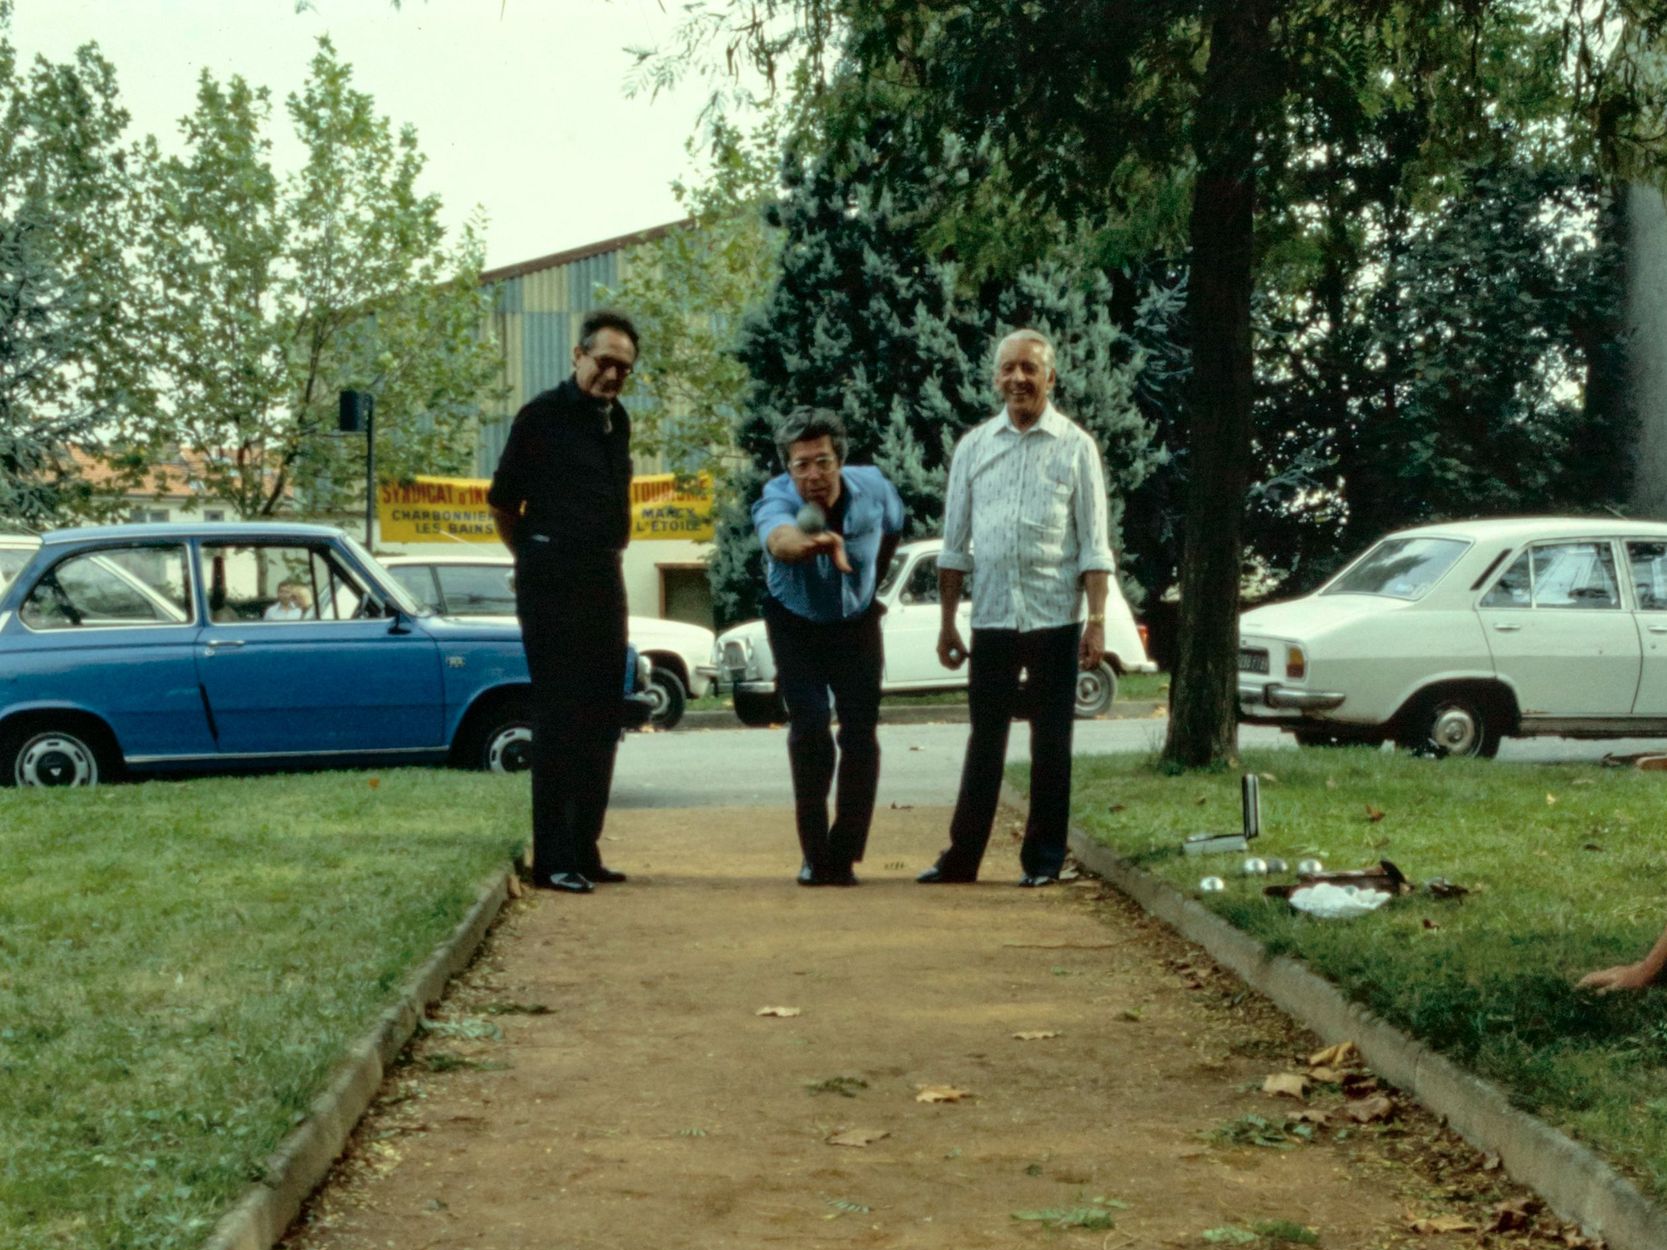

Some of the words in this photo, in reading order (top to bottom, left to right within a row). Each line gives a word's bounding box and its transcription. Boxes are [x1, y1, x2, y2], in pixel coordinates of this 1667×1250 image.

[382, 483, 453, 504] SYNDICAT
[415, 523, 441, 534] LES
[448, 523, 494, 535] BAINS
